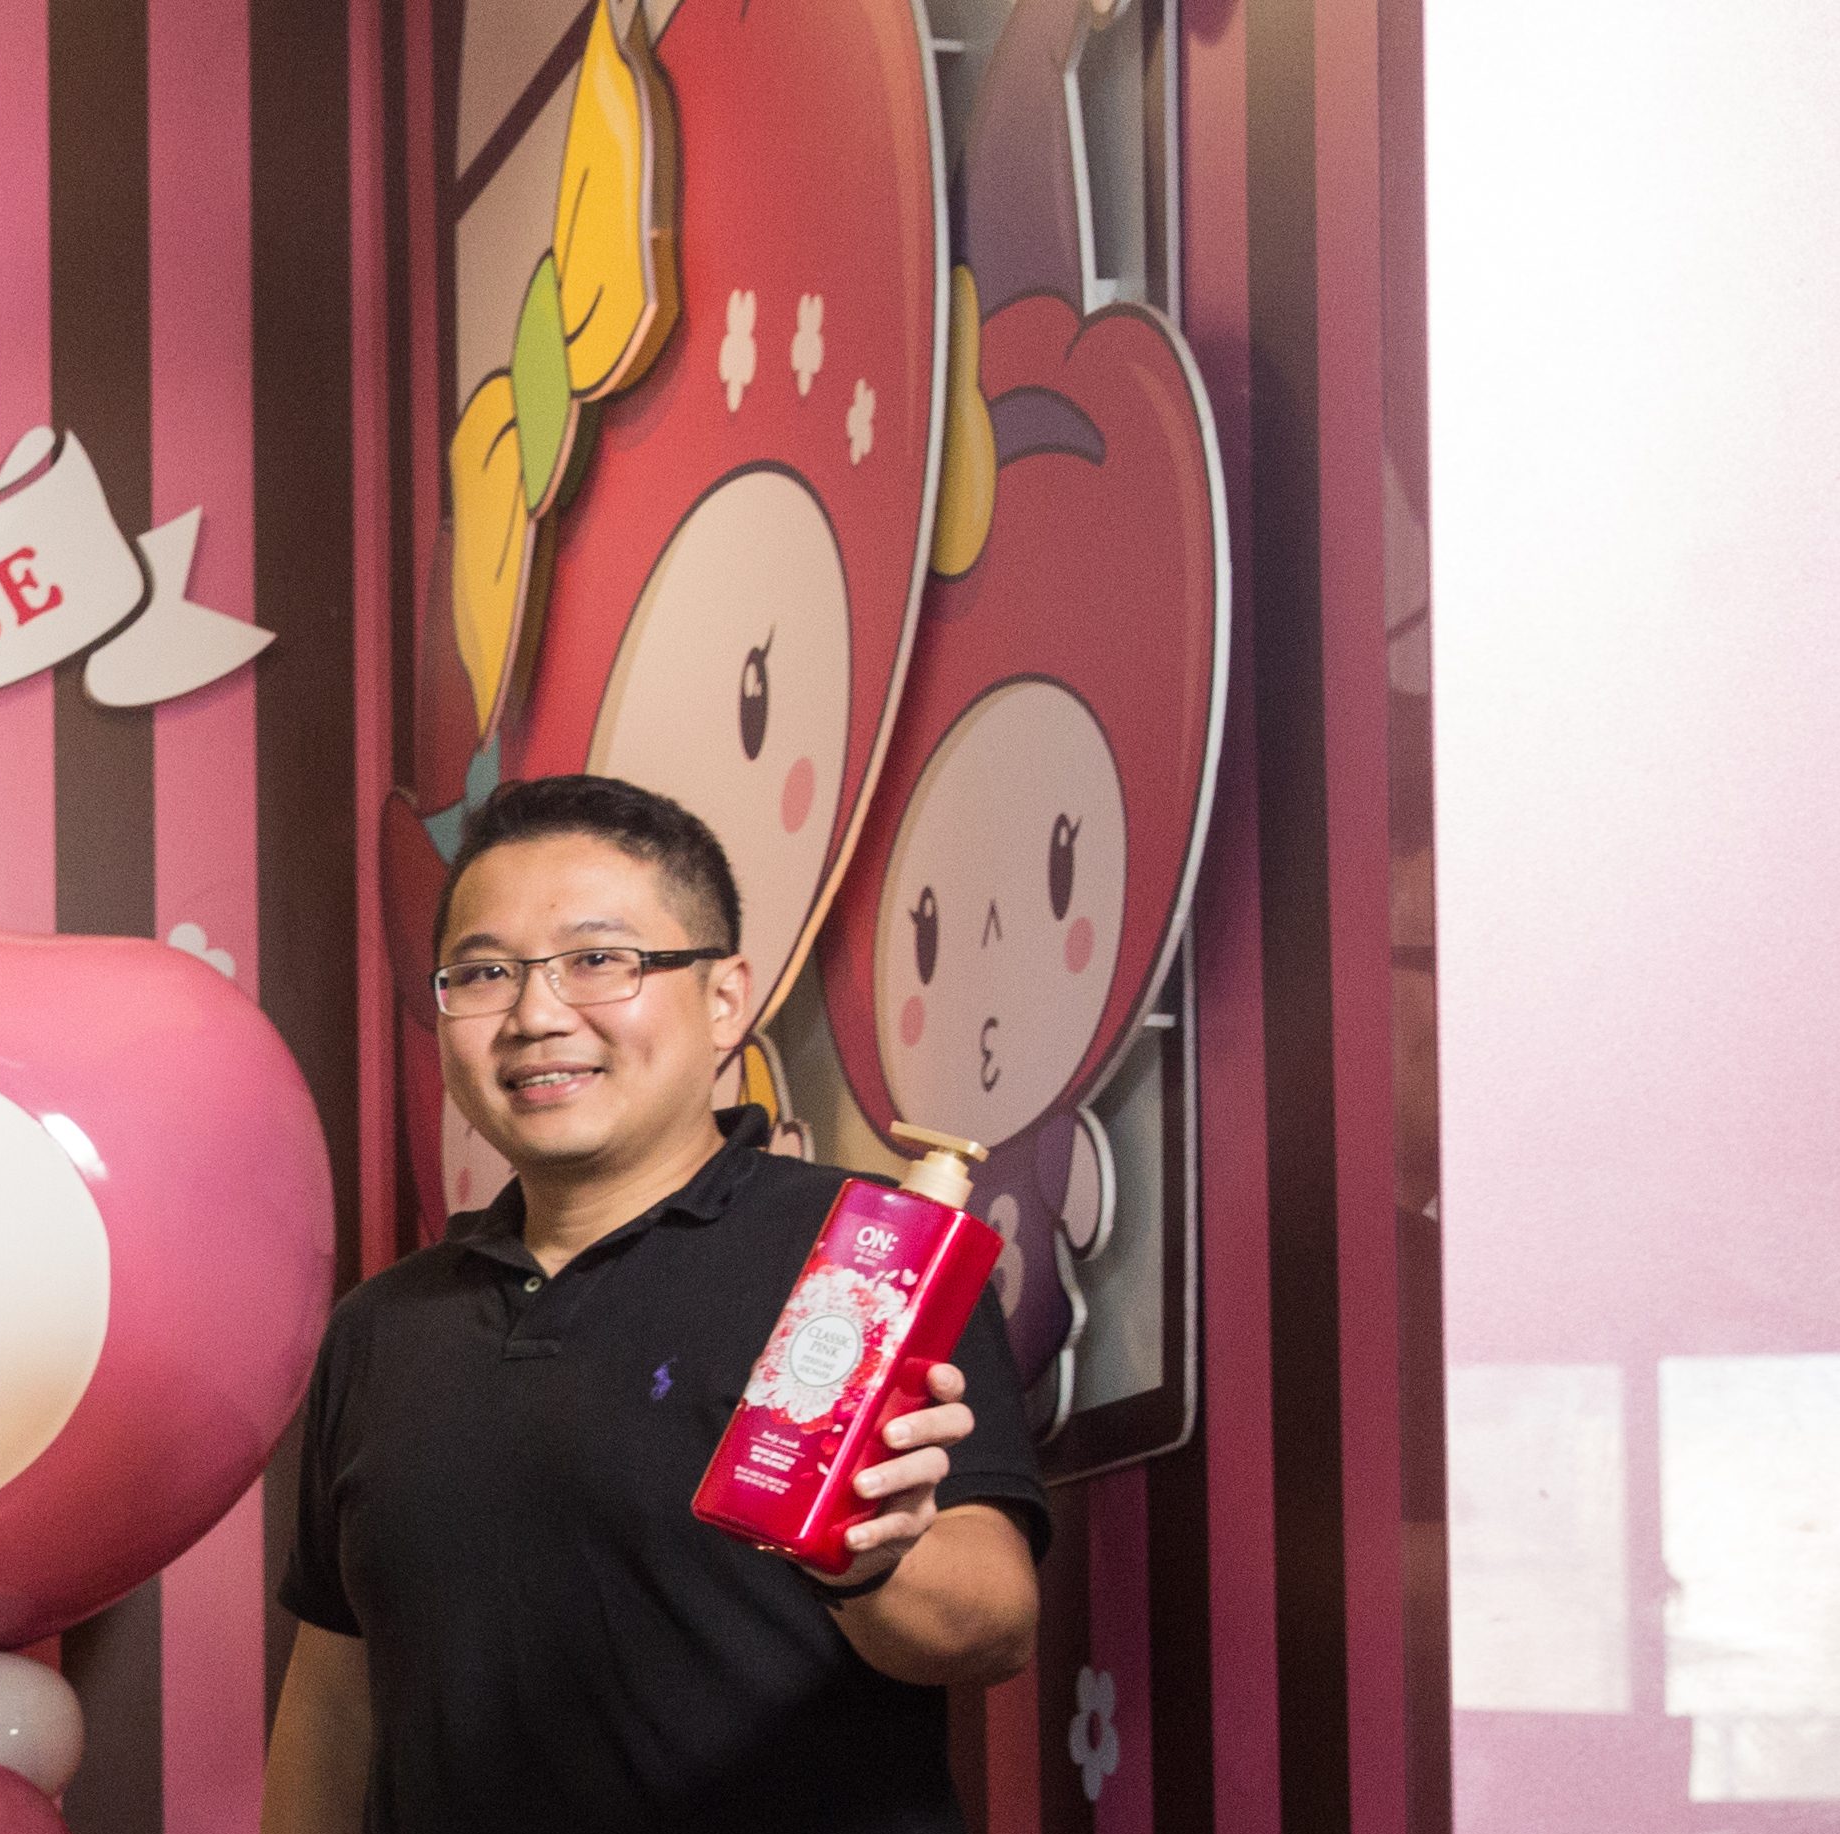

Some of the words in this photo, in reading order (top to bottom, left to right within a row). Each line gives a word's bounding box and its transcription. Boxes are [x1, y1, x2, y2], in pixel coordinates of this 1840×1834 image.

[856, 1226, 899, 1252] ON:
[808, 1326, 854, 1349] CLASSIC
[809, 1340, 842, 1358] PINK
